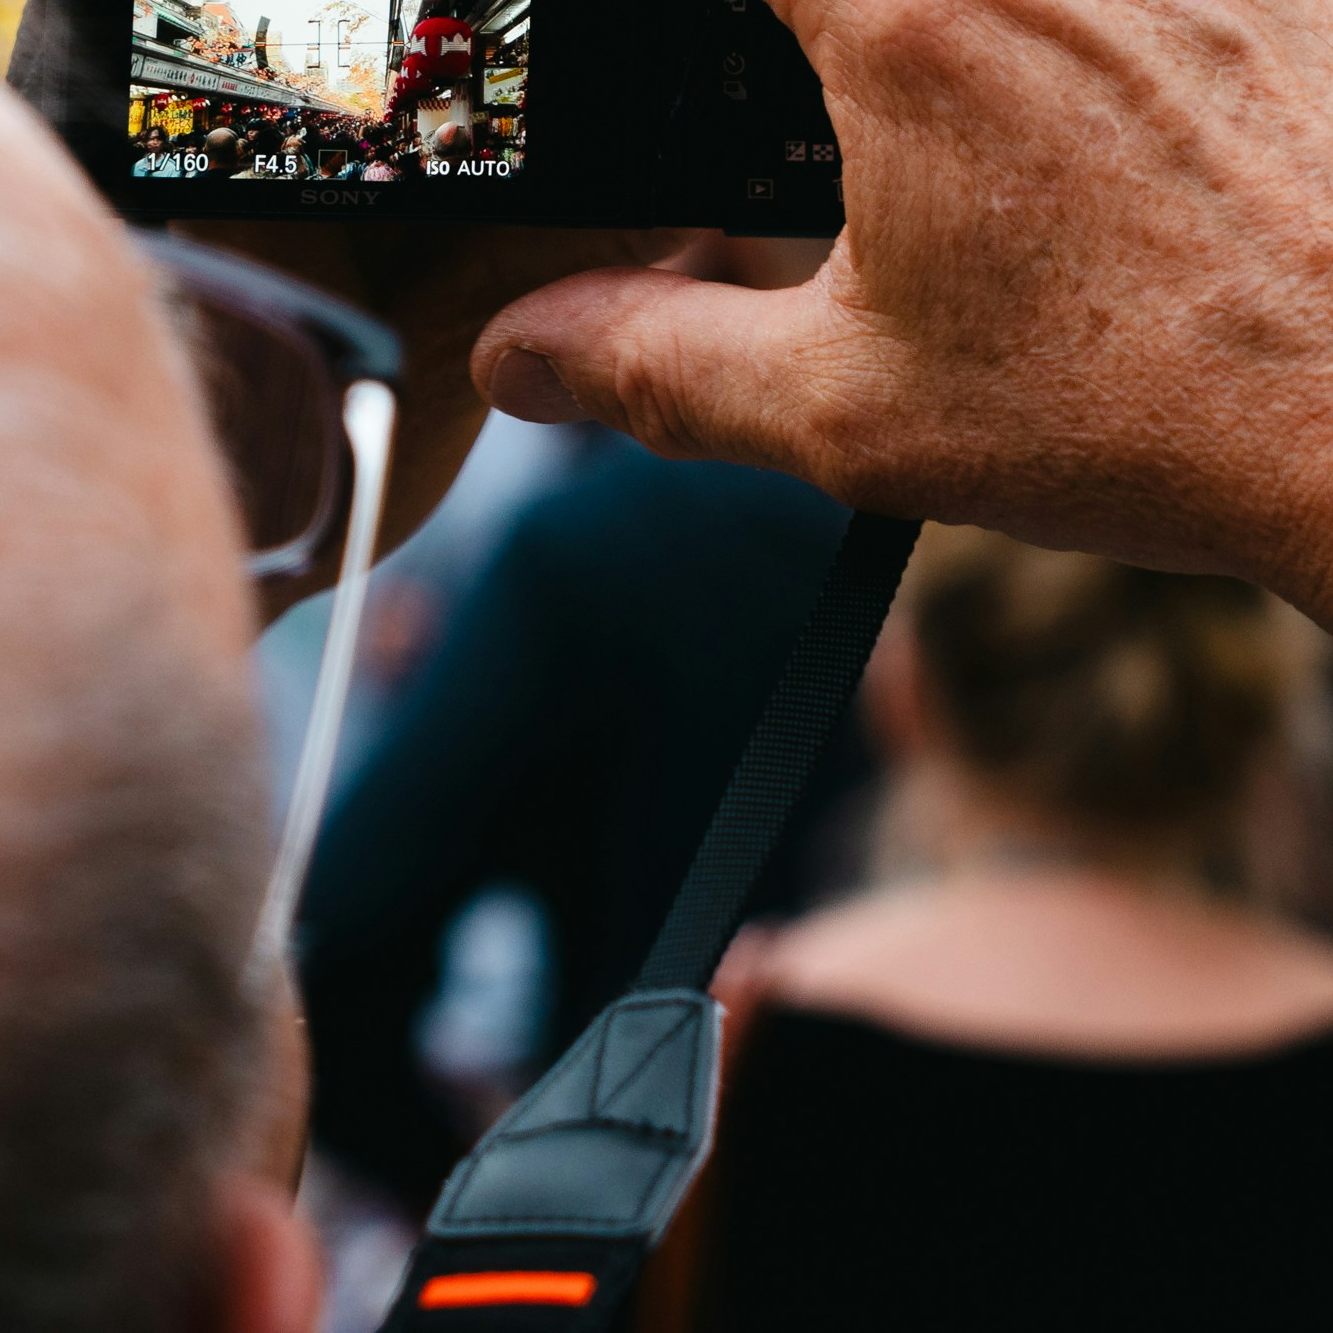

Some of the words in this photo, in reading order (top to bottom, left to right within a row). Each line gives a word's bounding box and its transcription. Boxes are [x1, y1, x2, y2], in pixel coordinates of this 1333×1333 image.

[148, 153, 209, 172] 1/160
[254, 154, 298, 174] F4.5
[426, 160, 450, 176] ISO
[456, 160, 511, 177] AUTO
[300, 189, 382, 206] SONY
